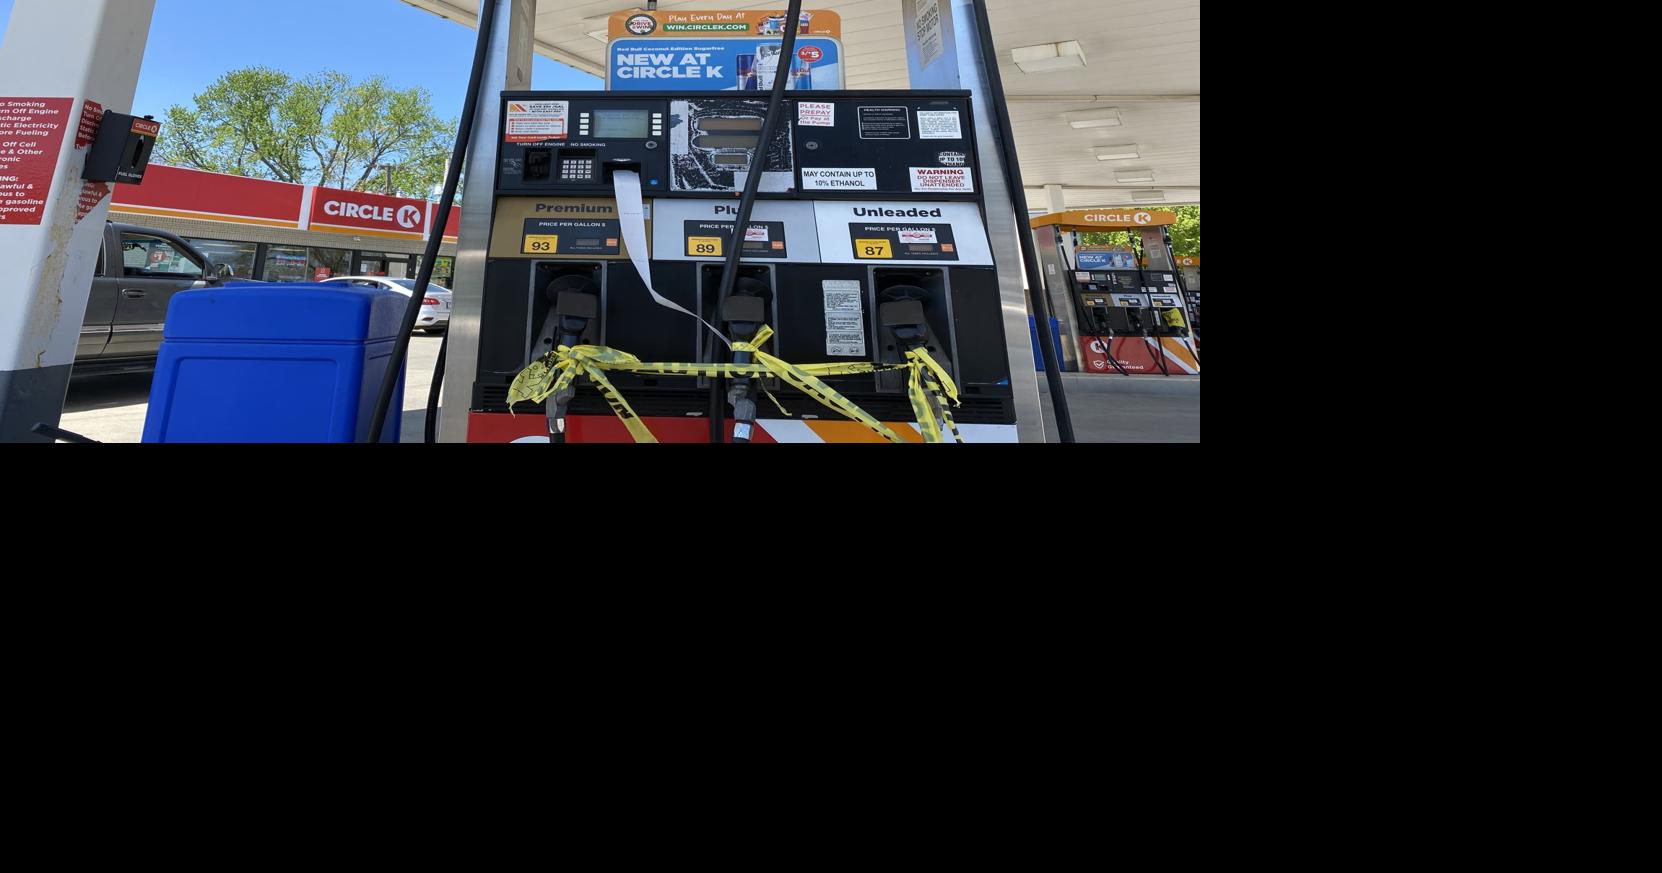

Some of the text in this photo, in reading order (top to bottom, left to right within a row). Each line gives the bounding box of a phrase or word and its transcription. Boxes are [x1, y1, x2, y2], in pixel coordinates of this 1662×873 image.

[669, 14, 687, 22] Play
[690, 13, 714, 22] Every
[716, 12, 732, 20] Day
[616, 53, 711, 66] NEW AT
[616, 66, 724, 79] CIRCLE K
[536, 203, 612, 213] Premium
[714, 205, 740, 214] Plu
[853, 208, 942, 218] Unleaded
[324, 200, 419, 227] CIRCLE K
[1136, 213, 1150, 223] K
[532, 242, 550, 251] 93
[696, 244, 715, 253] 89
[865, 246, 884, 256] 87
